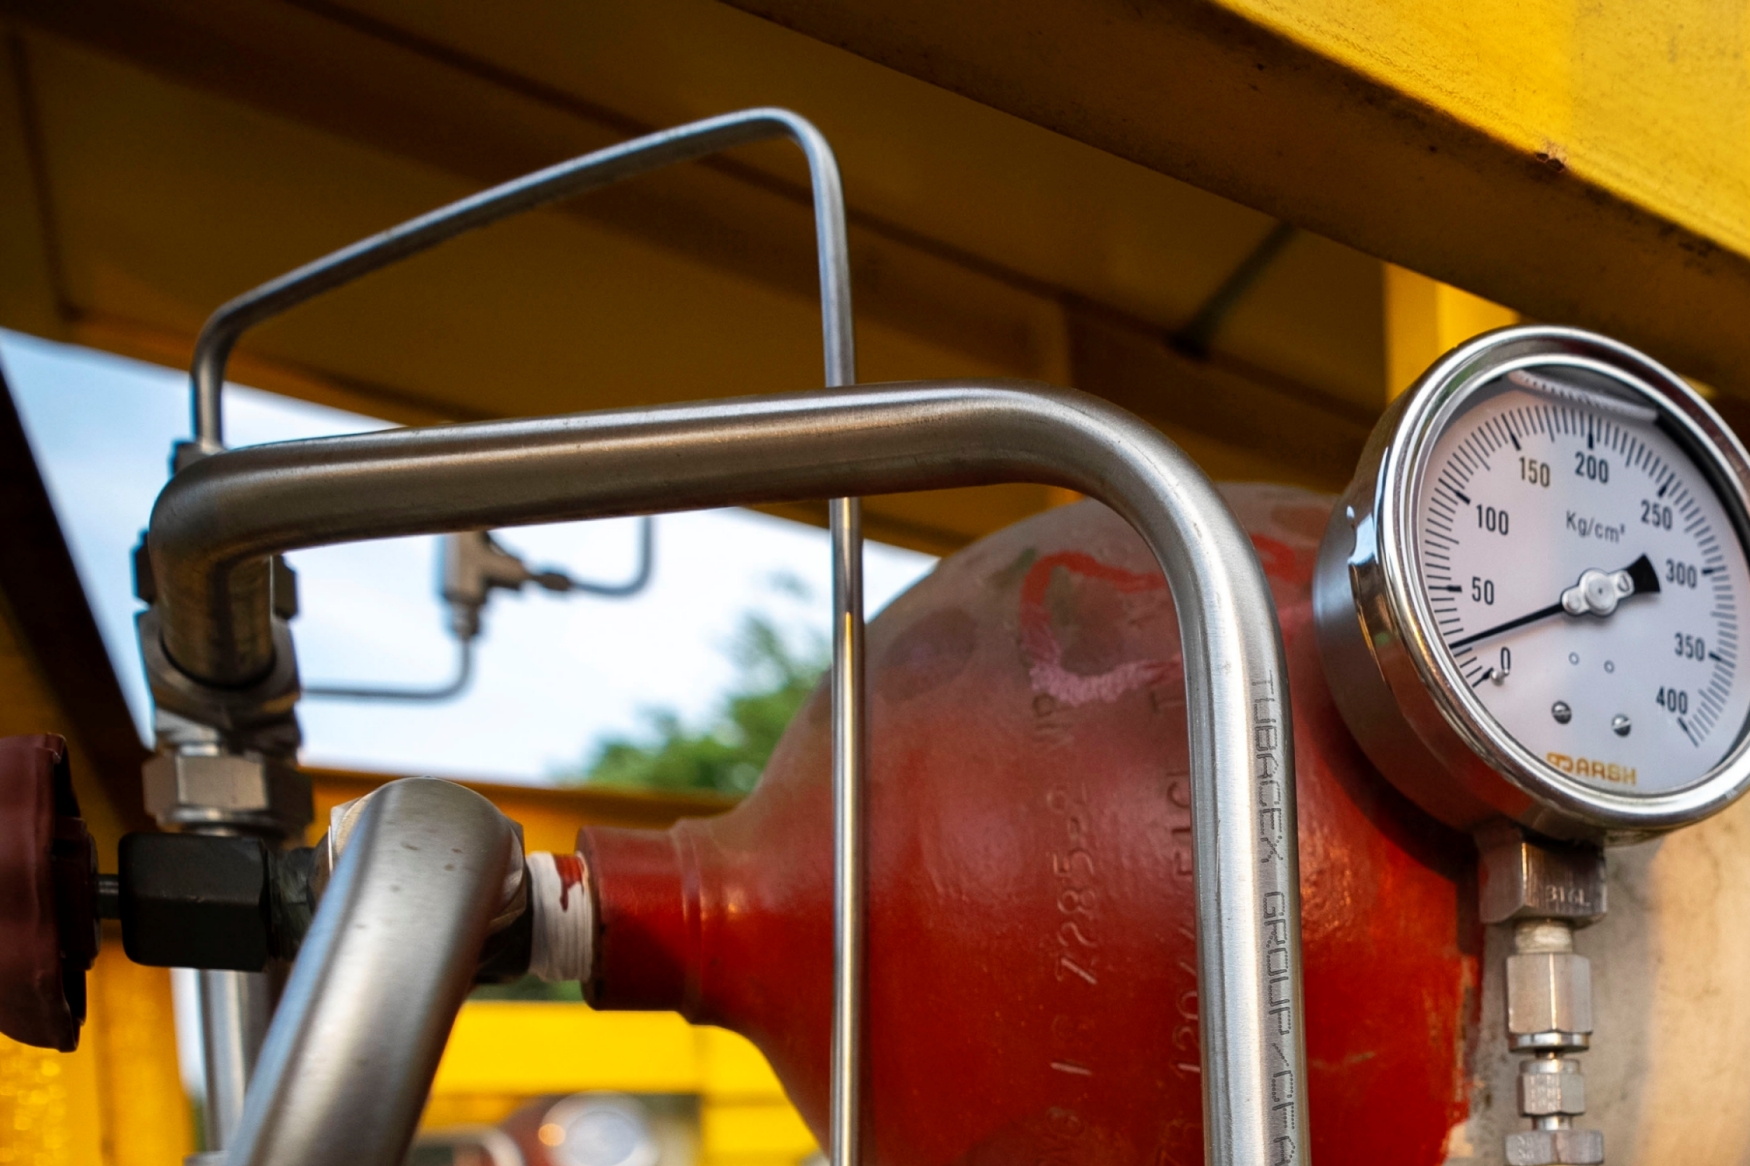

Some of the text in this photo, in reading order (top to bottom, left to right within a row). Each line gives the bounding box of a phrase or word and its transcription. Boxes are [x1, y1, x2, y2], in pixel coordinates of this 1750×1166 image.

[1519, 456, 1551, 488] 150
[1574, 451, 1610, 485] 200
[1476, 504, 1509, 536] 100
[1640, 500, 1673, 531] 250
[1665, 559, 1697, 589] 300
[1471, 577, 1495, 605] 50
[1500, 646, 1511, 675] 0
[1673, 633, 1706, 662] 350
[1656, 686, 1689, 715] 400
[1250, 668, 1284, 864] TUBACEX
